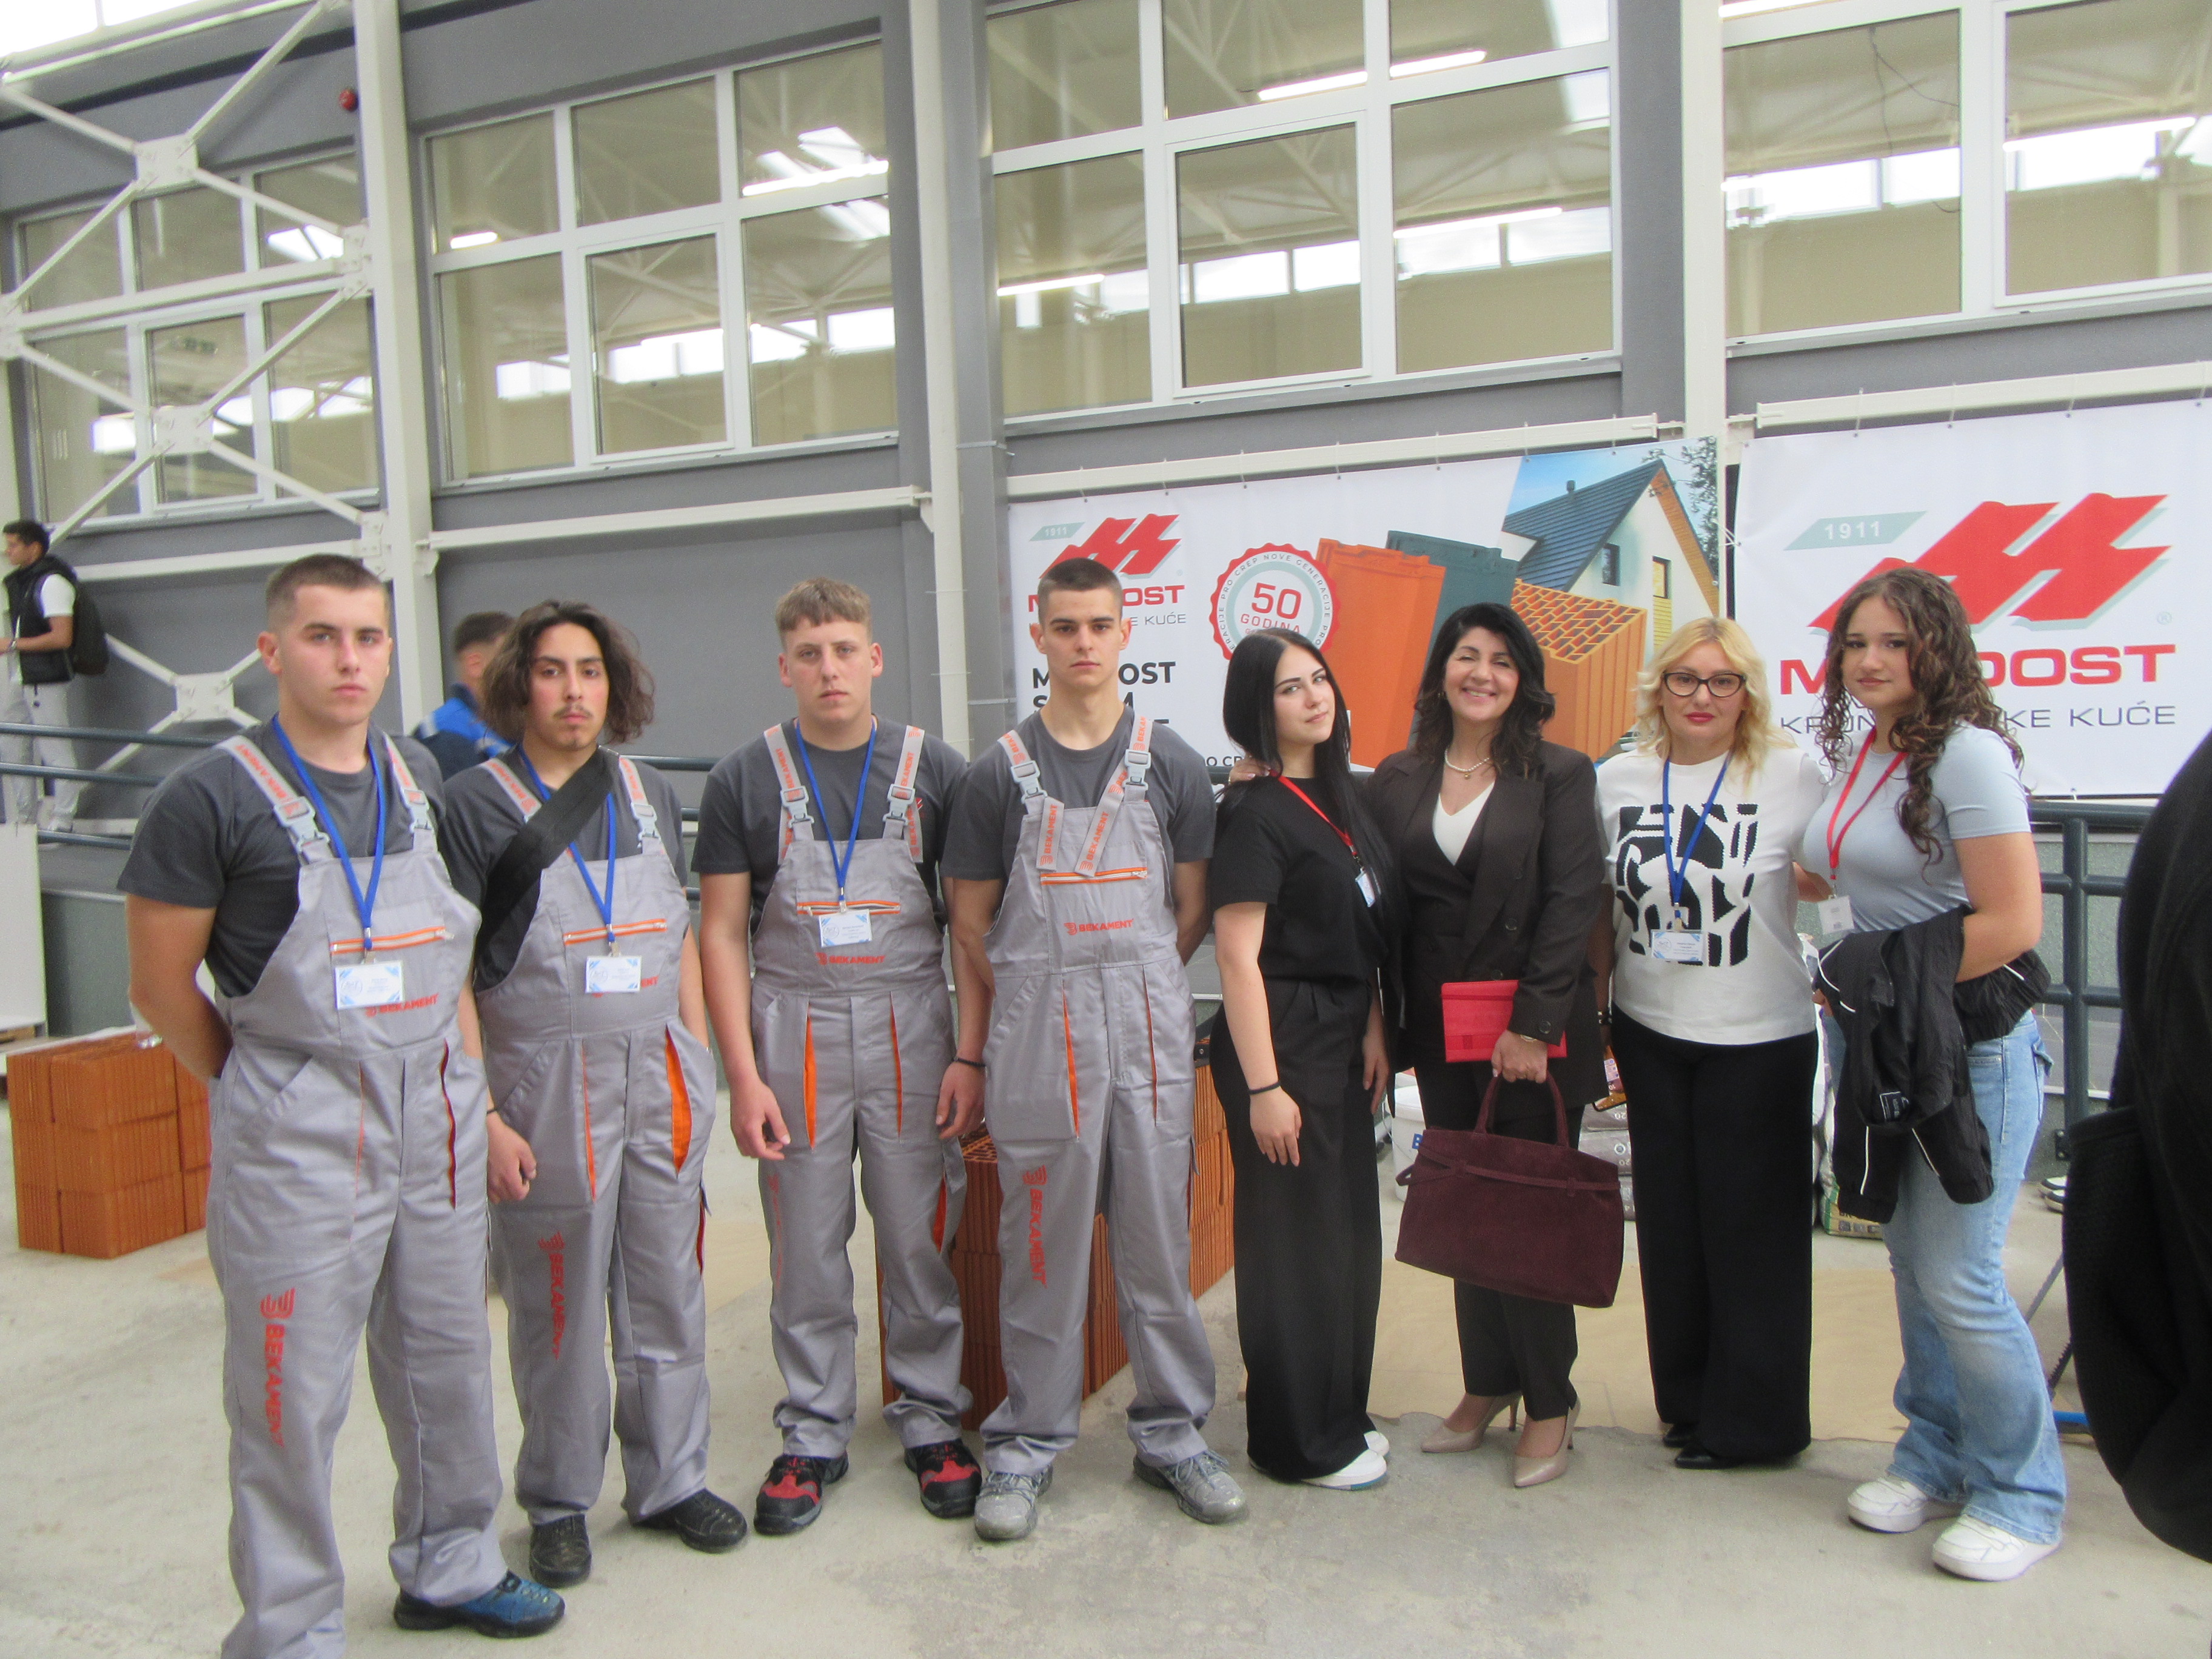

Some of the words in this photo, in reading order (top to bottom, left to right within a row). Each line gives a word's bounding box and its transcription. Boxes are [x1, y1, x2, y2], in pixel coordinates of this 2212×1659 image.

[1045, 526, 1068, 537] 1911
[1823, 520, 1882, 541] 1911
[1221, 580, 1233, 599] PRO
[1234, 557, 1258, 576] CREP
[1296, 559, 1331, 618] GENERACIJE
[1315, 625, 1328, 645] PRO
[1251, 582, 1302, 619] 50
[1144, 611, 1186, 625] KUĆE
[1240, 613, 1301, 634] GODINA
[2070, 700, 2176, 727] KUĆE
[901, 751, 914, 788] EKAMENT
[1044, 805, 1058, 854] BEKAMENT
[1086, 811, 1110, 861] BEKAMENT
[1079, 919, 1133, 933] BEKAMENT
[829, 955, 886, 964] BEKAMENT
[1029, 1188, 1048, 1289] BEKAMENT
[264, 1324, 286, 1449] BEKAMENT
